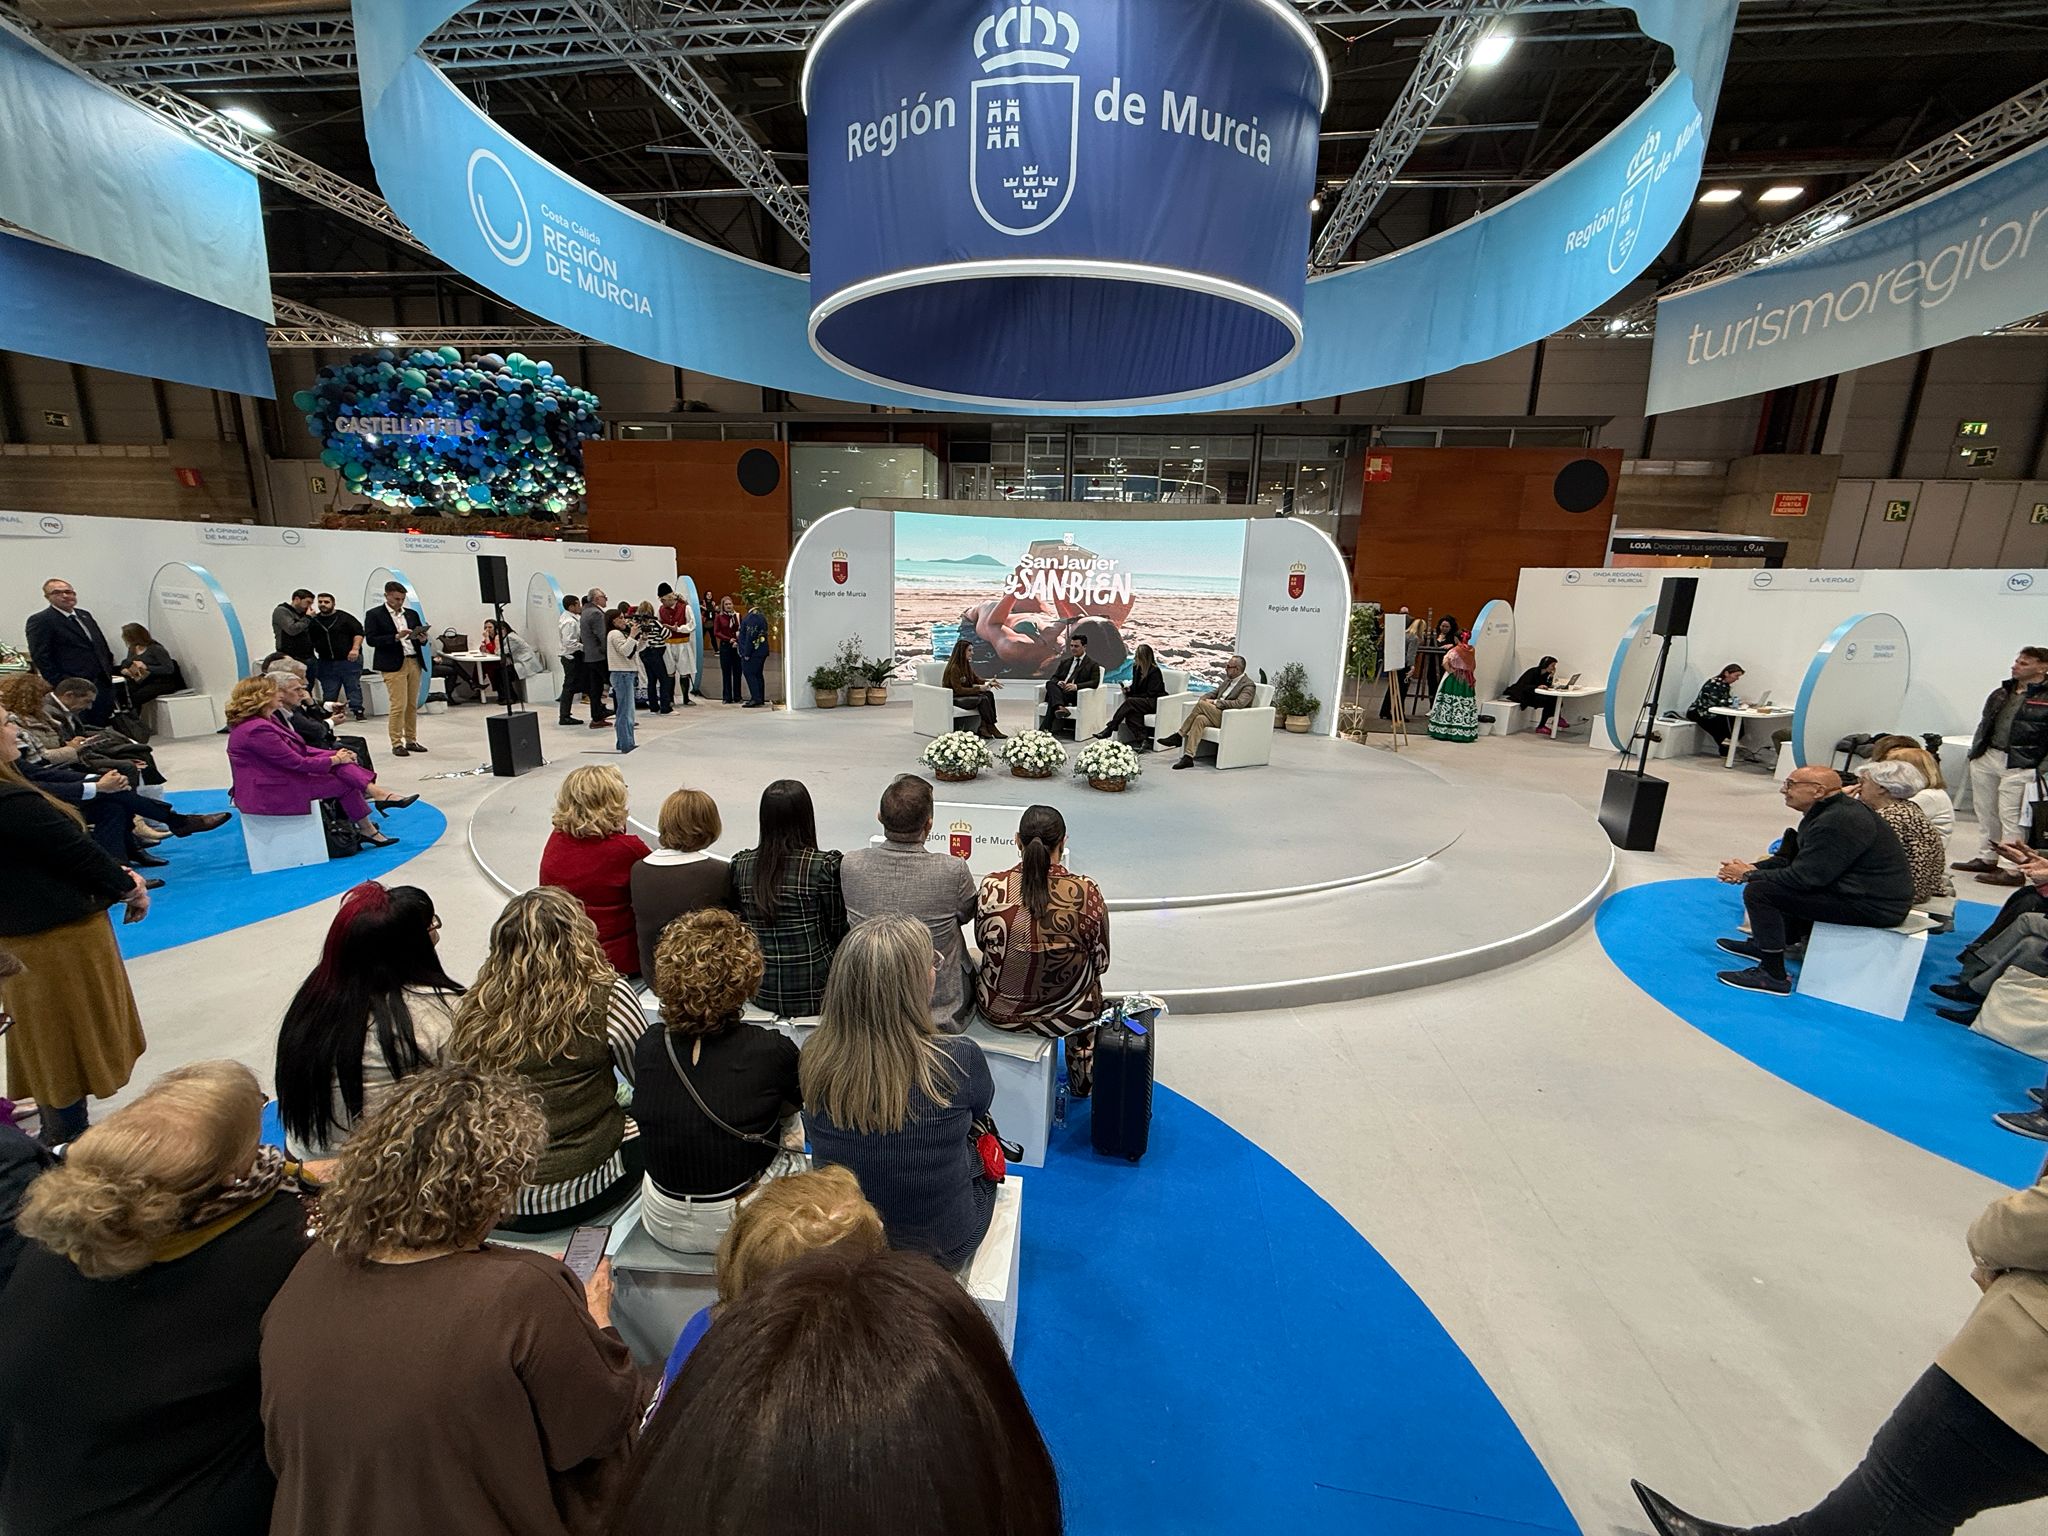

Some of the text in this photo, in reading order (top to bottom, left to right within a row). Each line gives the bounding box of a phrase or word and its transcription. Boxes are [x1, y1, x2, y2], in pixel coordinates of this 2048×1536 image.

[847, 77, 1271, 165] Región de Murcia
[1565, 206, 1615, 254] Región
[1654, 151, 1671, 183] de
[541, 204, 601, 245] Costa Cálida
[542, 224, 618, 281] REGIÓN
[545, 250, 653, 318] DE MURCIA
[0, 516, 23, 524] NAL
[1630, 542, 1651, 550] LOJA
[2011, 578, 2029, 586] tve
[815, 590, 835, 598] Región
[1268, 604, 1289, 613] Región
[1300, 605, 1321, 613] Murcia
[975, 836, 987, 844] de
